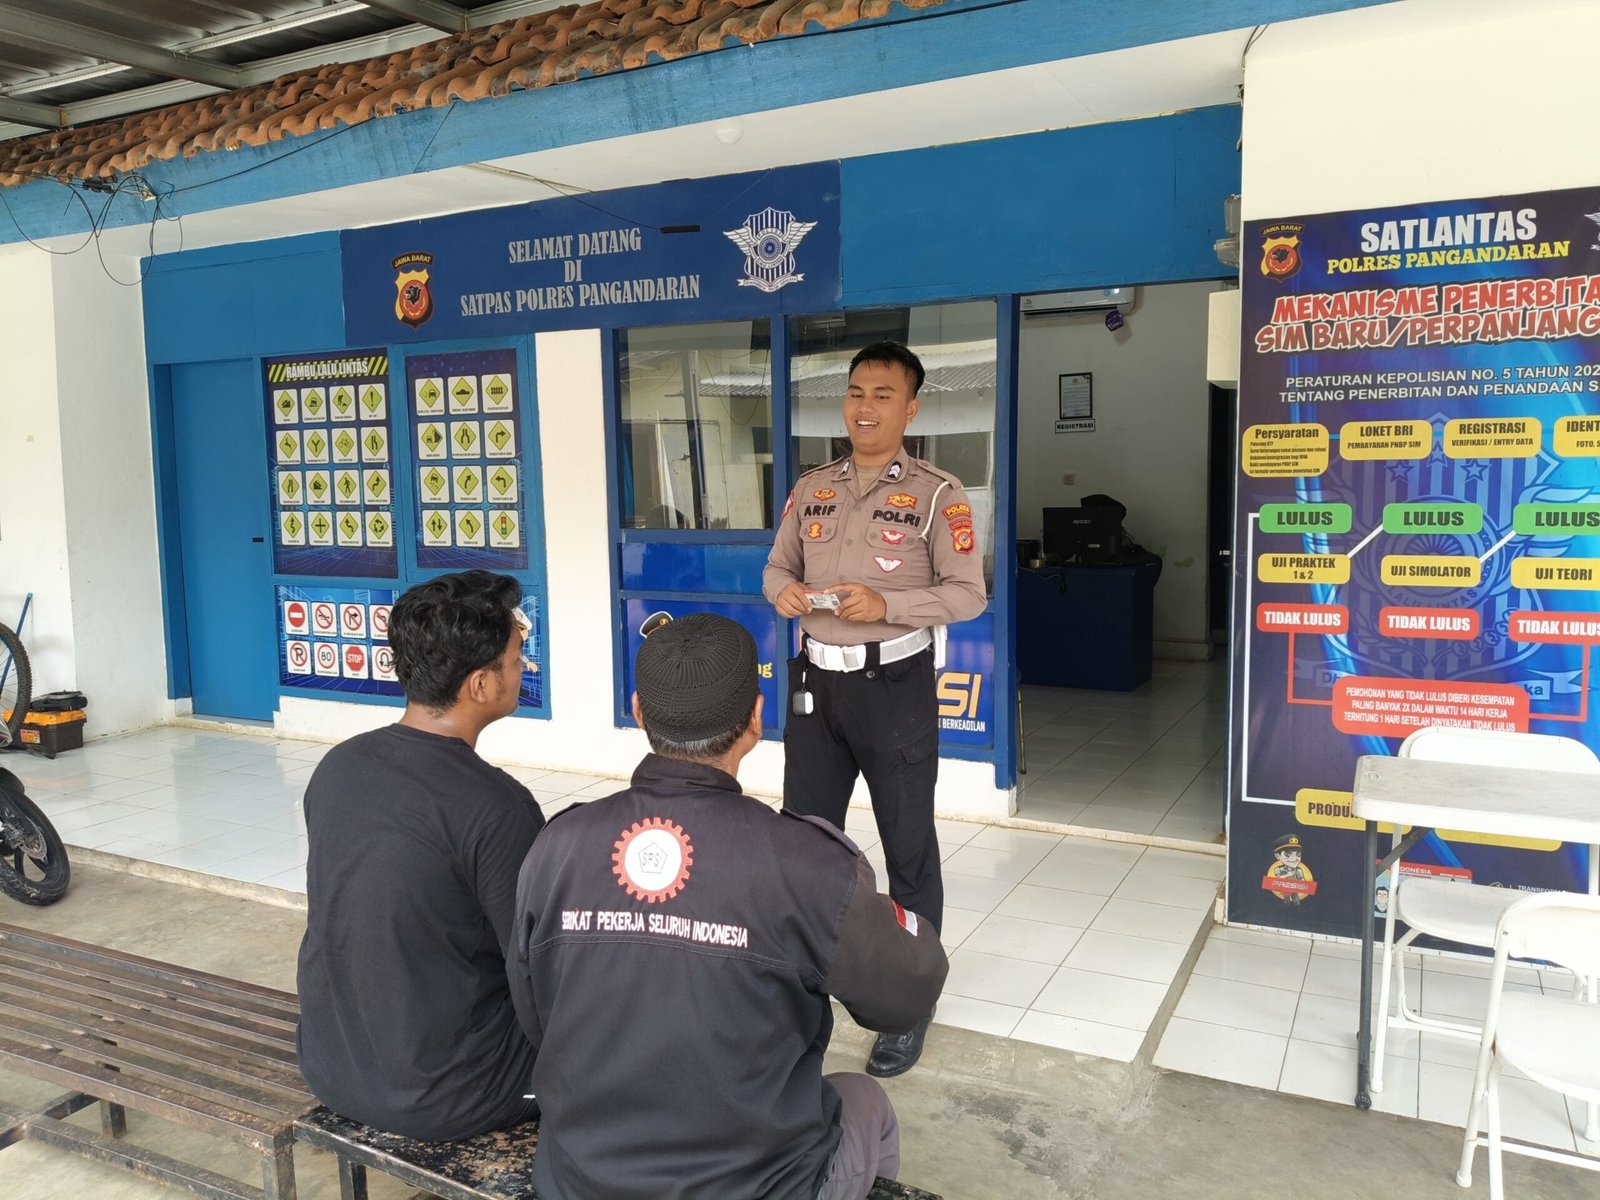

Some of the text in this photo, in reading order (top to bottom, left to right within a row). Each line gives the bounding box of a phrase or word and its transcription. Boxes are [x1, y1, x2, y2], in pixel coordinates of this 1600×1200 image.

[1262, 224, 1302, 235] JAWA BARAT
[1360, 208, 1538, 254] SATLANTAS
[508, 227, 642, 264] SELAMAT DATANG
[394, 254, 432, 268] JAWA BARAT
[1327, 240, 1570, 275] POLRES PANGANDARAN
[564, 260, 583, 283] DI
[461, 275, 701, 317] SATPAS POLRES PANGANDARAN
[1272, 286, 1438, 325] MEKANISME
[1255, 321, 1308, 353] SIM
[286, 360, 368, 379] RAMBU LALU LINTAS
[1286, 372, 1374, 388] PERATURAN
[1376, 370, 1468, 385] KEPOLISIAN
[1471, 368, 1498, 381] NO.
[1502, 367, 1512, 380] 5
[1514, 365, 1570, 380] TAHUN
[1279, 388, 1345, 404] TENTANG
[1348, 386, 1444, 401] PENERBITAN
[1446, 384, 1481, 397] DAN
[1483, 381, 1581, 396] PENANDAAN
[1056, 422, 1094, 430] REGISTRASI
[1255, 428, 1320, 440] Persyaratan
[1360, 424, 1413, 437] LOKET BRI
[1458, 422, 1526, 436] REGISTRASI
[1408, 440, 1421, 448] SIM
[1452, 438, 1488, 446] VERIFIKASI
[1494, 438, 1515, 446] ENTRY
[1516, 438, 1534, 446] DATA
[803, 504, 921, 528] ARIF POLRI
[1276, 510, 1600, 527] LULUS LULUS LULUS
[1272, 556, 1336, 570] UJI PRAKTEK
[1390, 564, 1472, 578] UJI SIMOLATOR
[1293, 570, 1298, 580] 1
[1307, 570, 1314, 580] 2
[1535, 567, 1593, 581] UJI TEORI
[1264, 610, 1342, 626] TIDAK LULUS
[1387, 615, 1471, 632] TIDAK LULUS
[1517, 619, 1559, 634] TIDAK
[321, 651, 332, 662] 80
[347, 654, 363, 663] STOP
[1346, 686, 1516, 706] PEMOHONAN YANG TIDAK LULUS DIBERI KESEMPATAN
[1352, 700, 1508, 718] PALING BANYAK 2X DALAM WAKTU 14 HARI KERJA
[942, 718, 986, 732] BERKEADILAN
[1344, 711, 1516, 732] TERHITUNG 1 HARI SETELAH DINYATAKAN TIDAK LULUS
[1308, 802, 1359, 818] PRODU
[1400, 866, 1432, 875] DONESIA
[597, 911, 645, 932] PEKERJA
[648, 913, 691, 938] SELURUH
[692, 920, 748, 948] INDONESIA
